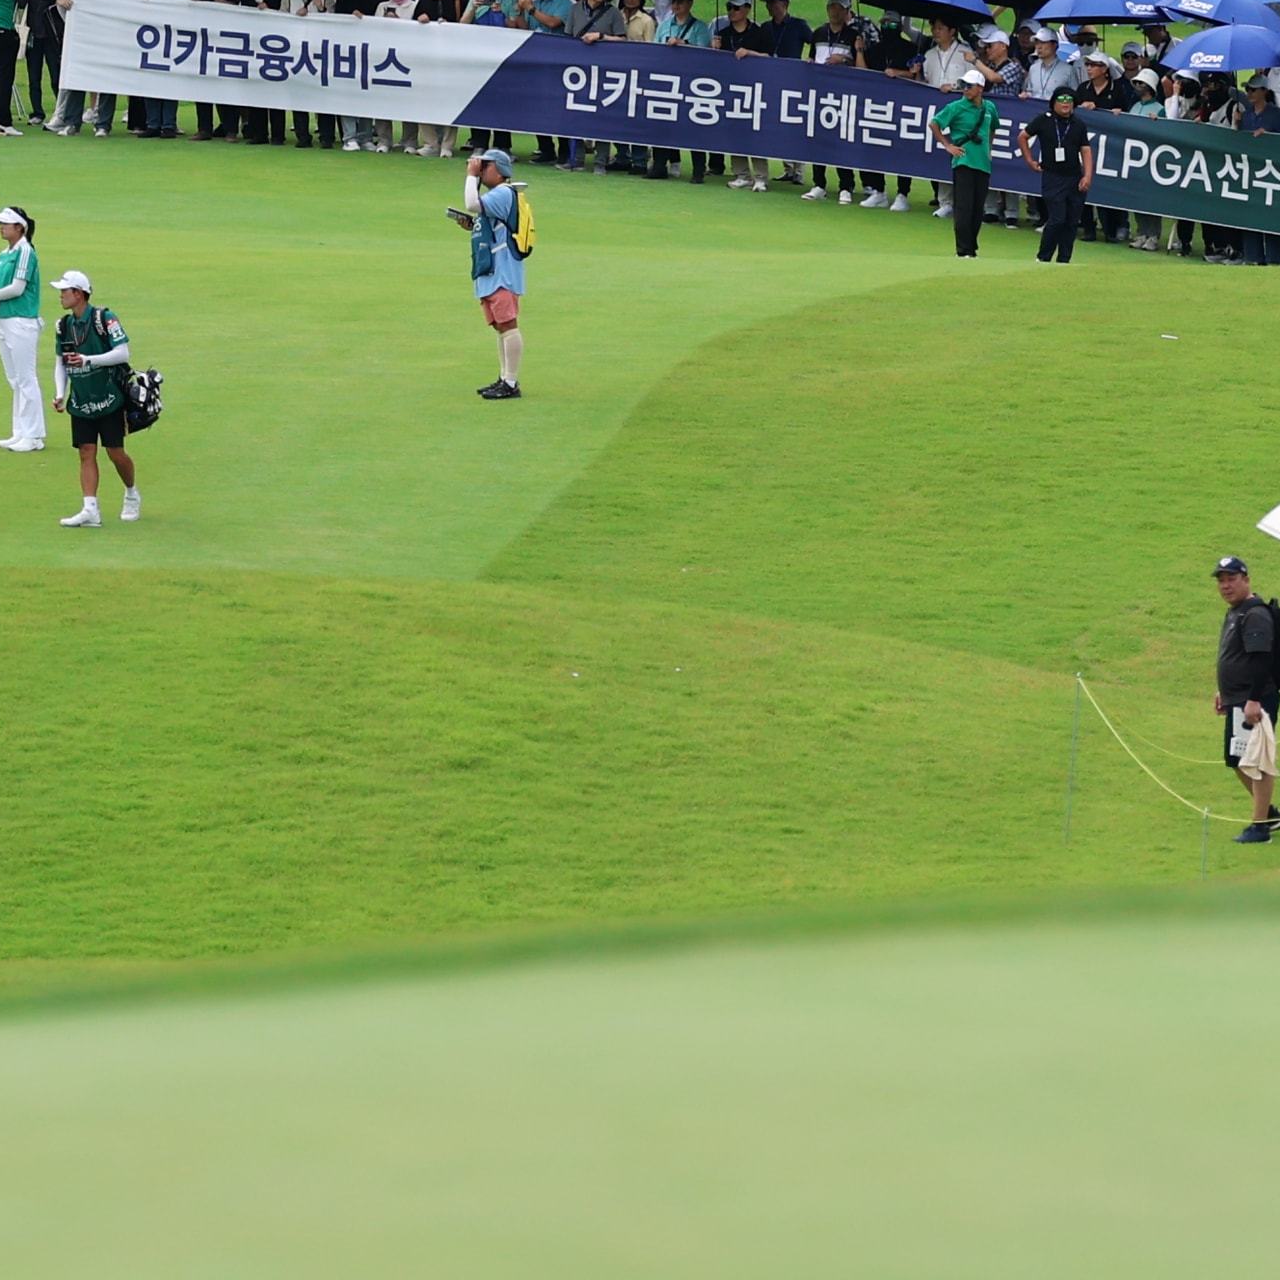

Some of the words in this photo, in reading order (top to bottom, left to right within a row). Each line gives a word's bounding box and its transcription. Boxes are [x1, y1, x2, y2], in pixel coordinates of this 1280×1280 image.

[136, 23, 412, 91] 인카금융서비스
[562, 65, 767, 131] 인카금융과
[780, 89, 1042, 167] 더헤븐리트
